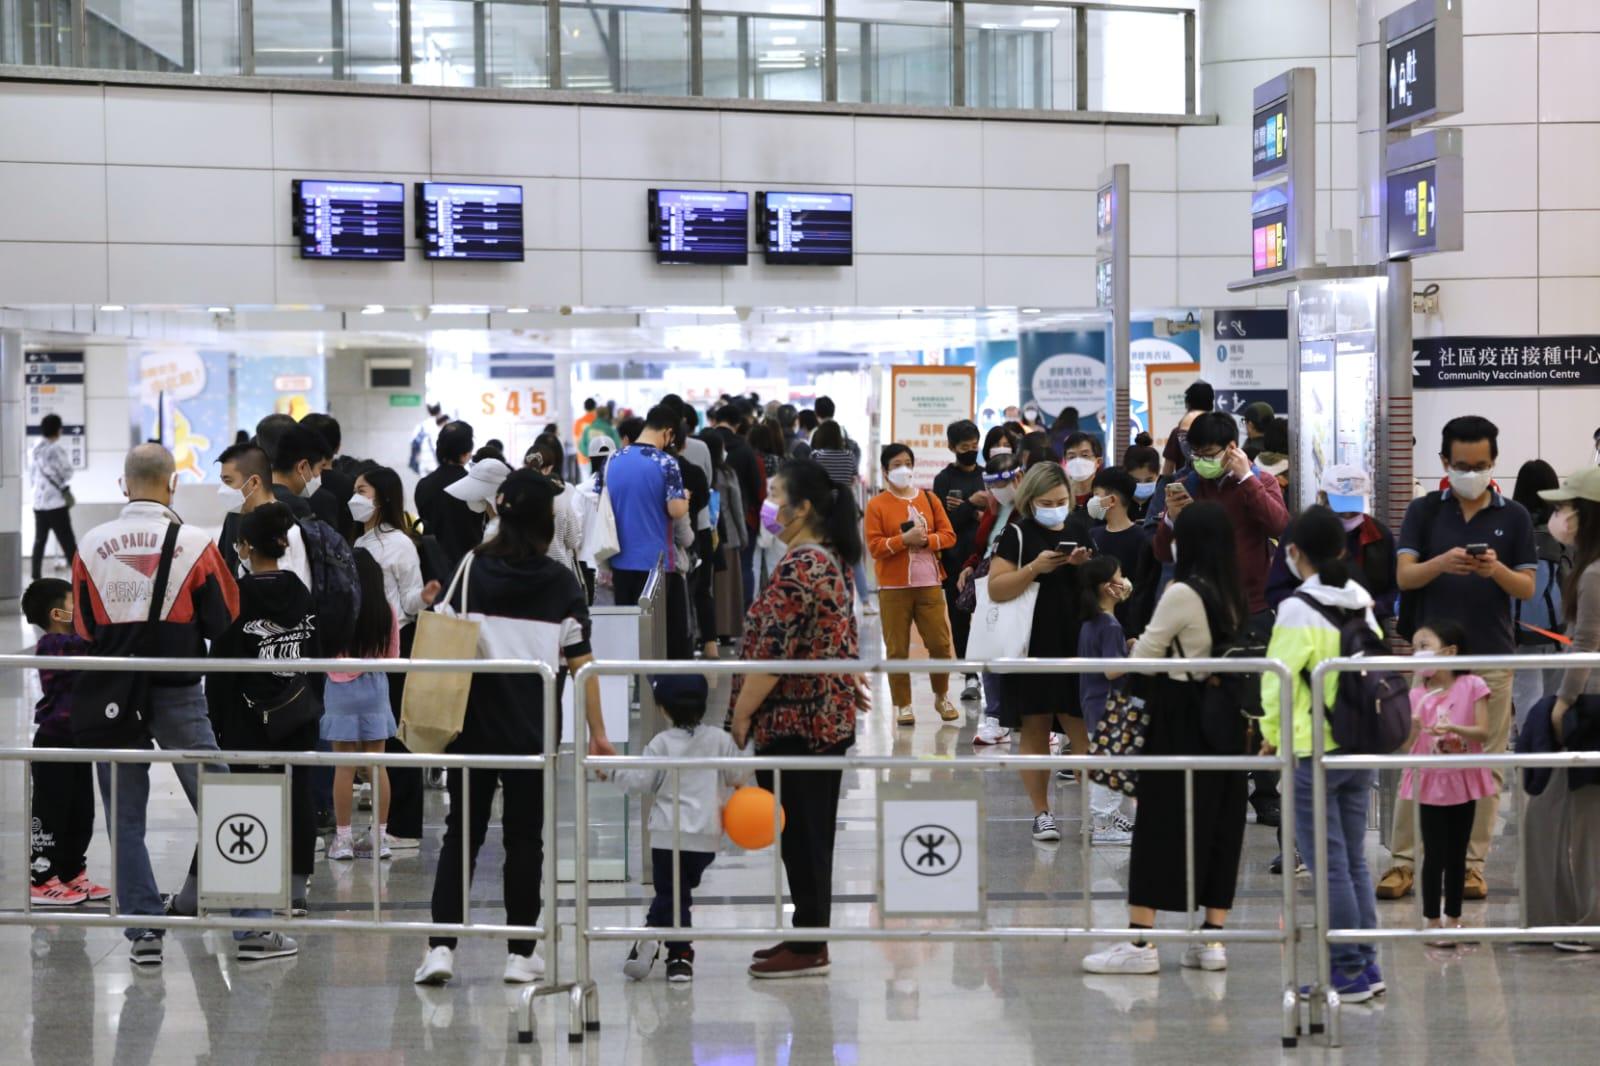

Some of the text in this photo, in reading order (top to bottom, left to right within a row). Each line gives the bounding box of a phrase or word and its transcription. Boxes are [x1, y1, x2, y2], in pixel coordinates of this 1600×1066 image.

[1438, 345, 1600, 367] 社區疫苗接種中心
[1438, 369, 1580, 381] Community Vaccination Centre
[121, 532, 158, 550] PAULO
